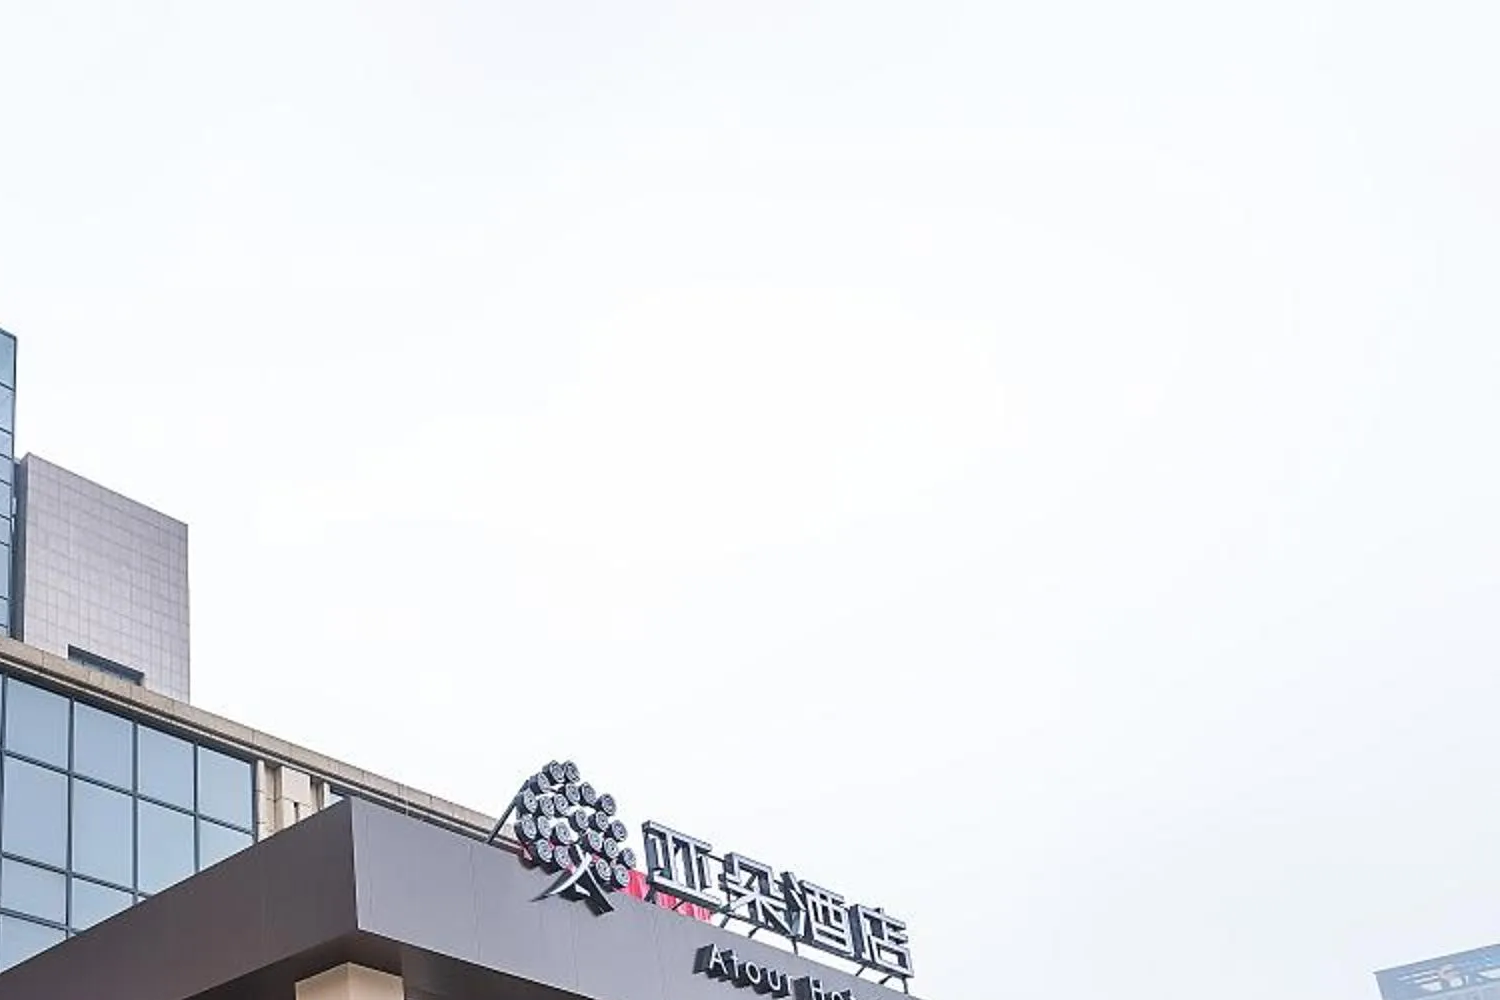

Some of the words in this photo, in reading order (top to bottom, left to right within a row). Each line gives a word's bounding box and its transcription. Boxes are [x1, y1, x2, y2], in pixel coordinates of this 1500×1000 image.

[642, 820, 915, 978] 亚朵酒店
[704, 943, 794, 997] Atour
